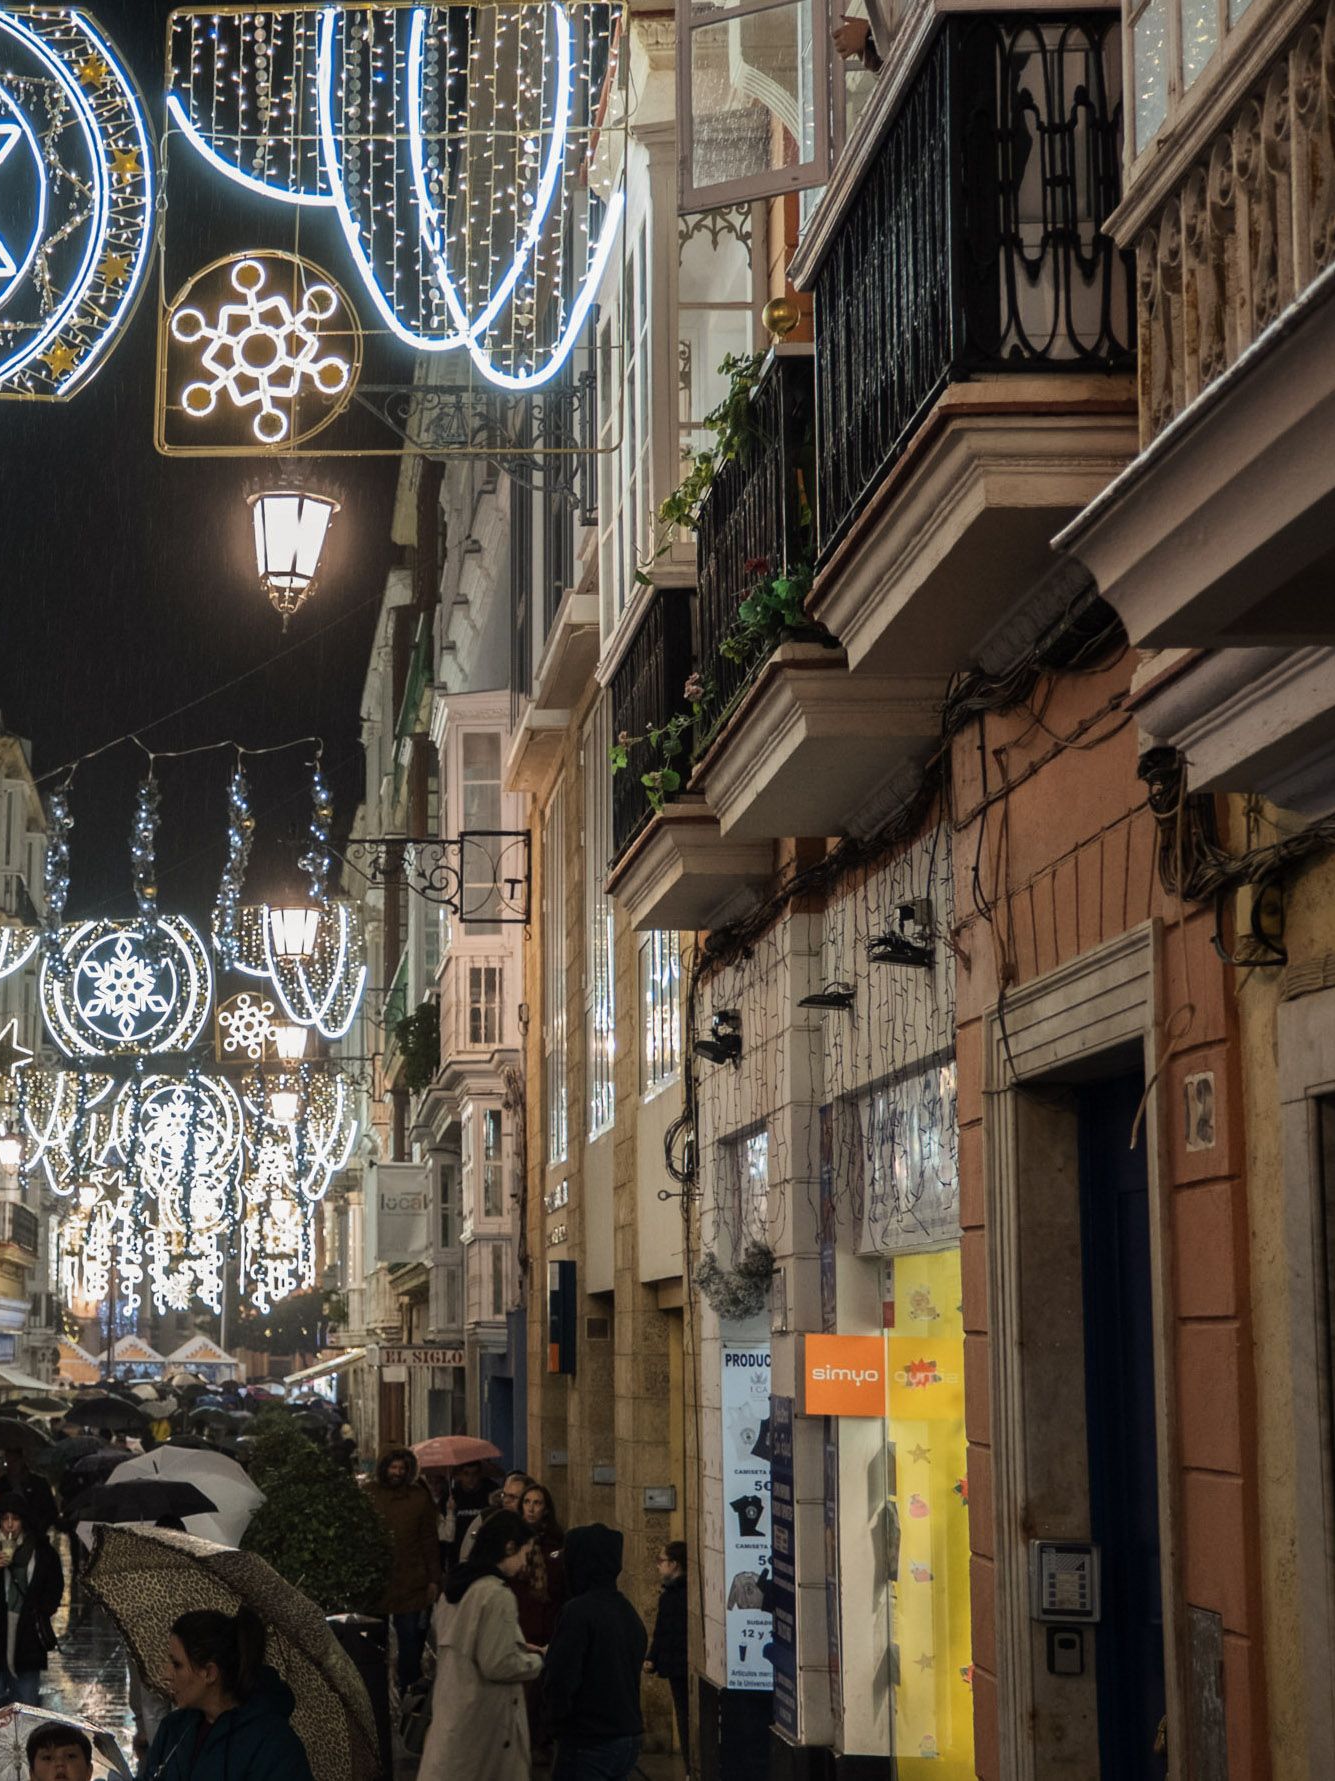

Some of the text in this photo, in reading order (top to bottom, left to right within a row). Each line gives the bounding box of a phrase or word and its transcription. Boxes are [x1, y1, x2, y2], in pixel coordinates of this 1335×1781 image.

[381, 1192, 428, 1210] local
[385, 1351, 463, 1364] EL SIGLO
[812, 1365, 879, 1387] simyo
[742, 1629, 755, 1638] 12
